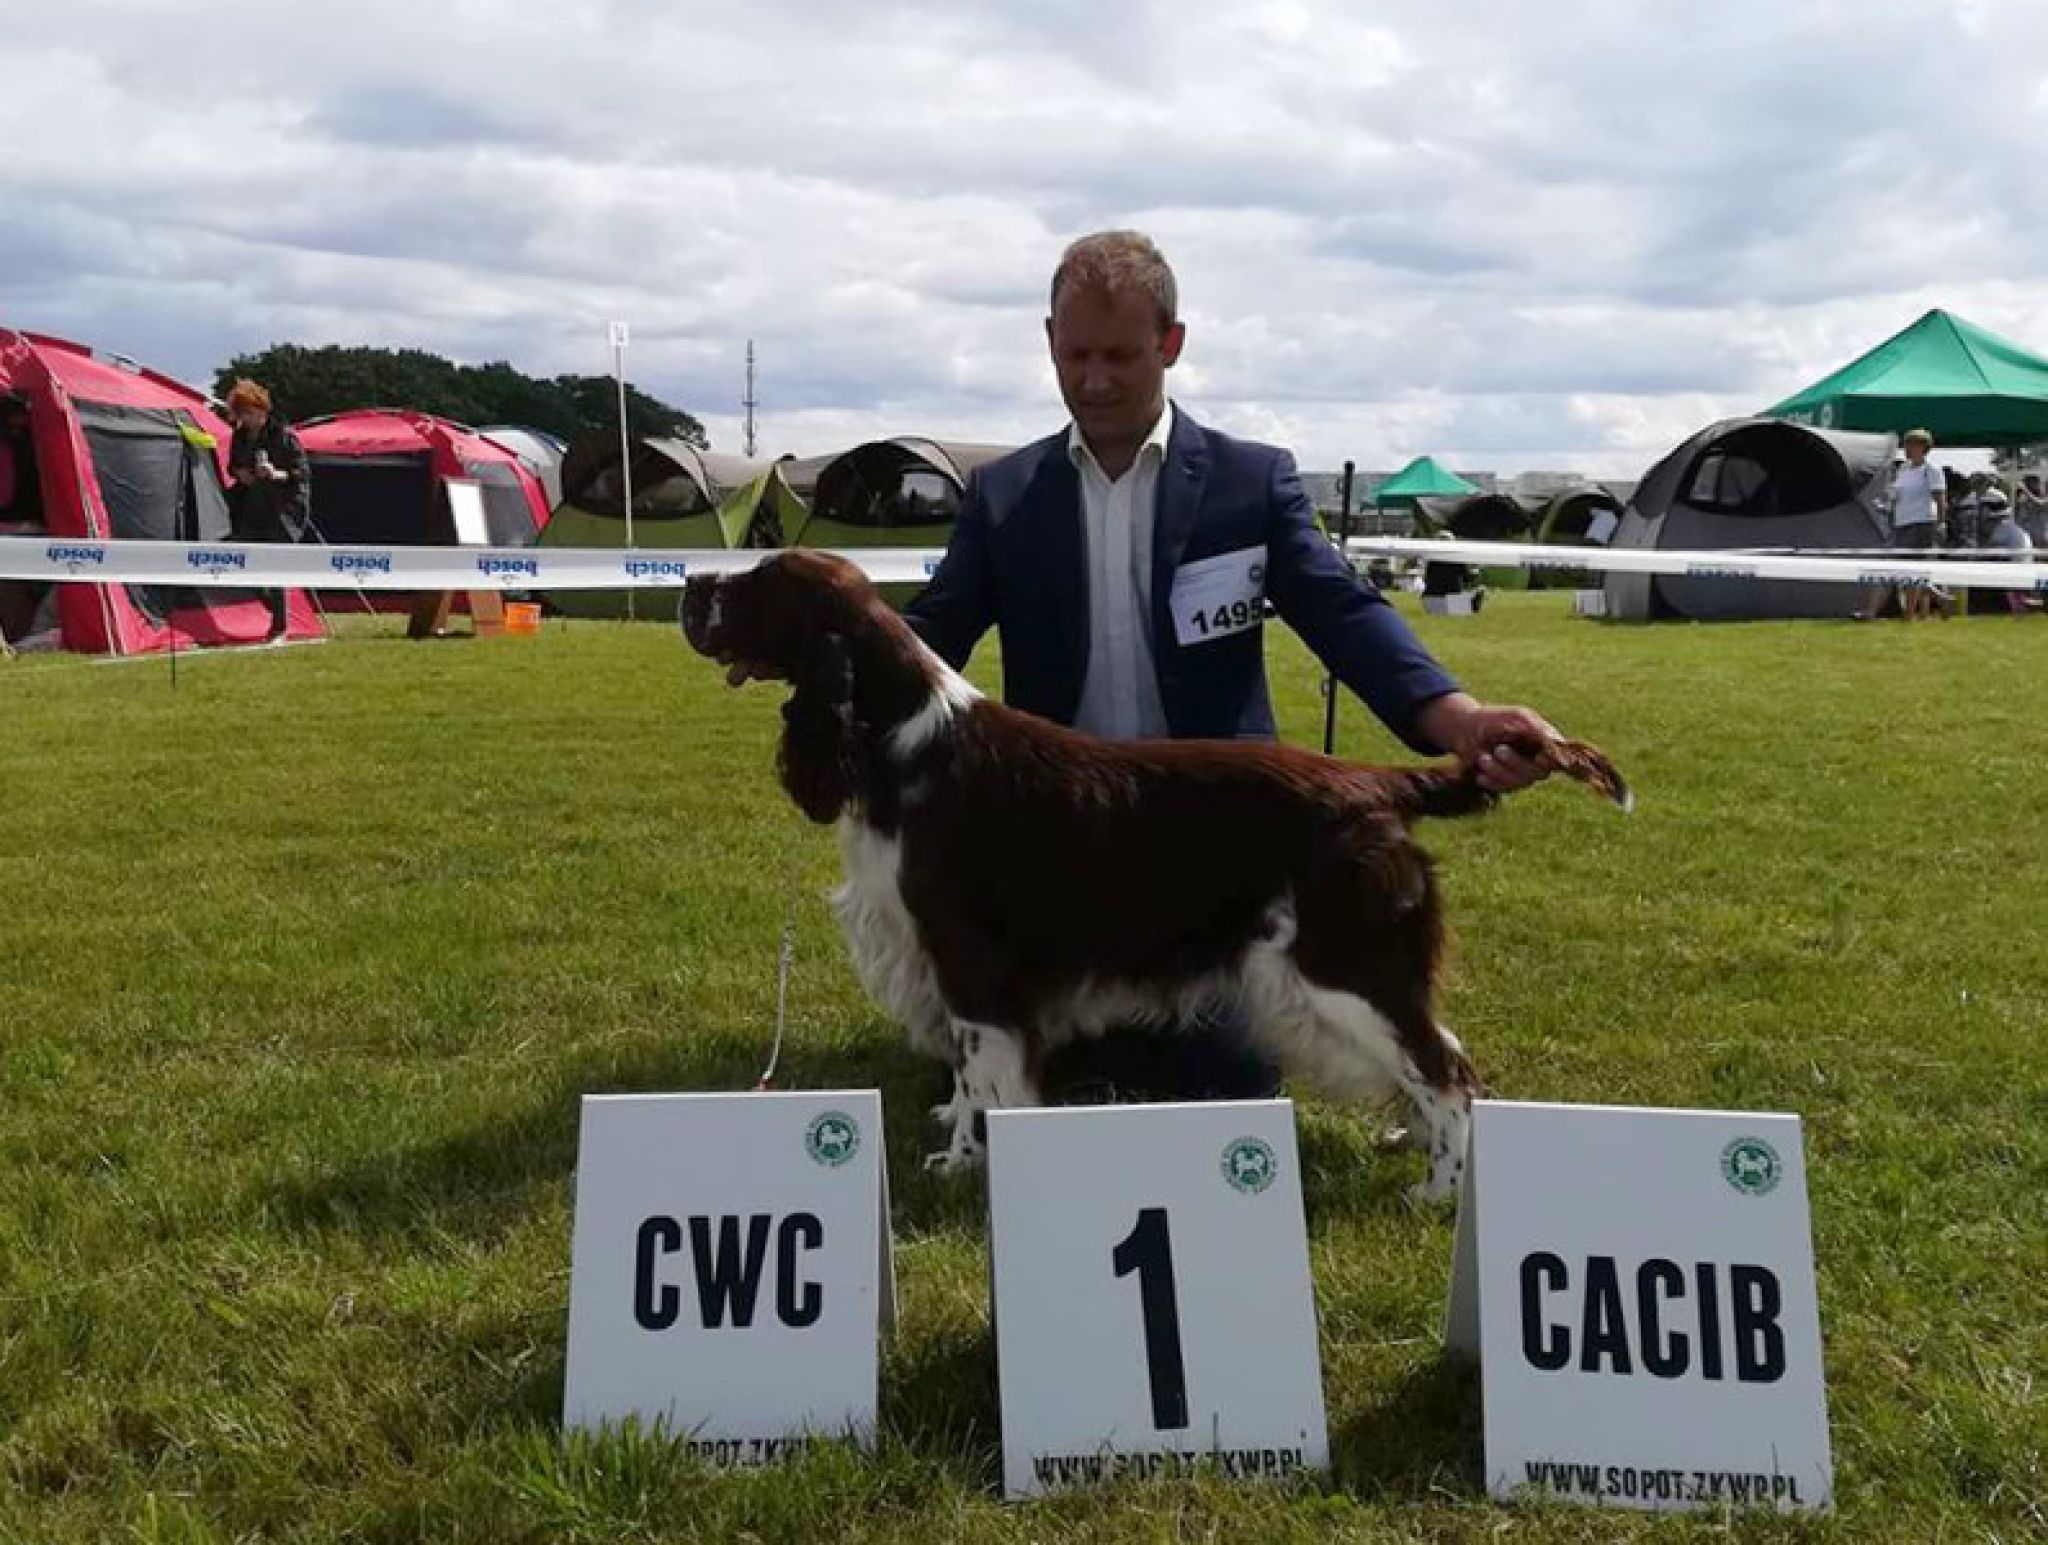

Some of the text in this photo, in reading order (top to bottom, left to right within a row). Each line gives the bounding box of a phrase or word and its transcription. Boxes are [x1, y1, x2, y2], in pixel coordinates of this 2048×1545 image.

[188, 551, 245, 569] bosch
[332, 555, 390, 573] bosch
[477, 558, 538, 576] bosch
[625, 560, 685, 577] bosch
[634, 1212, 823, 1331] CWC
[1112, 1207, 1189, 1430] 1
[1520, 1251, 1787, 1383] CACIB
